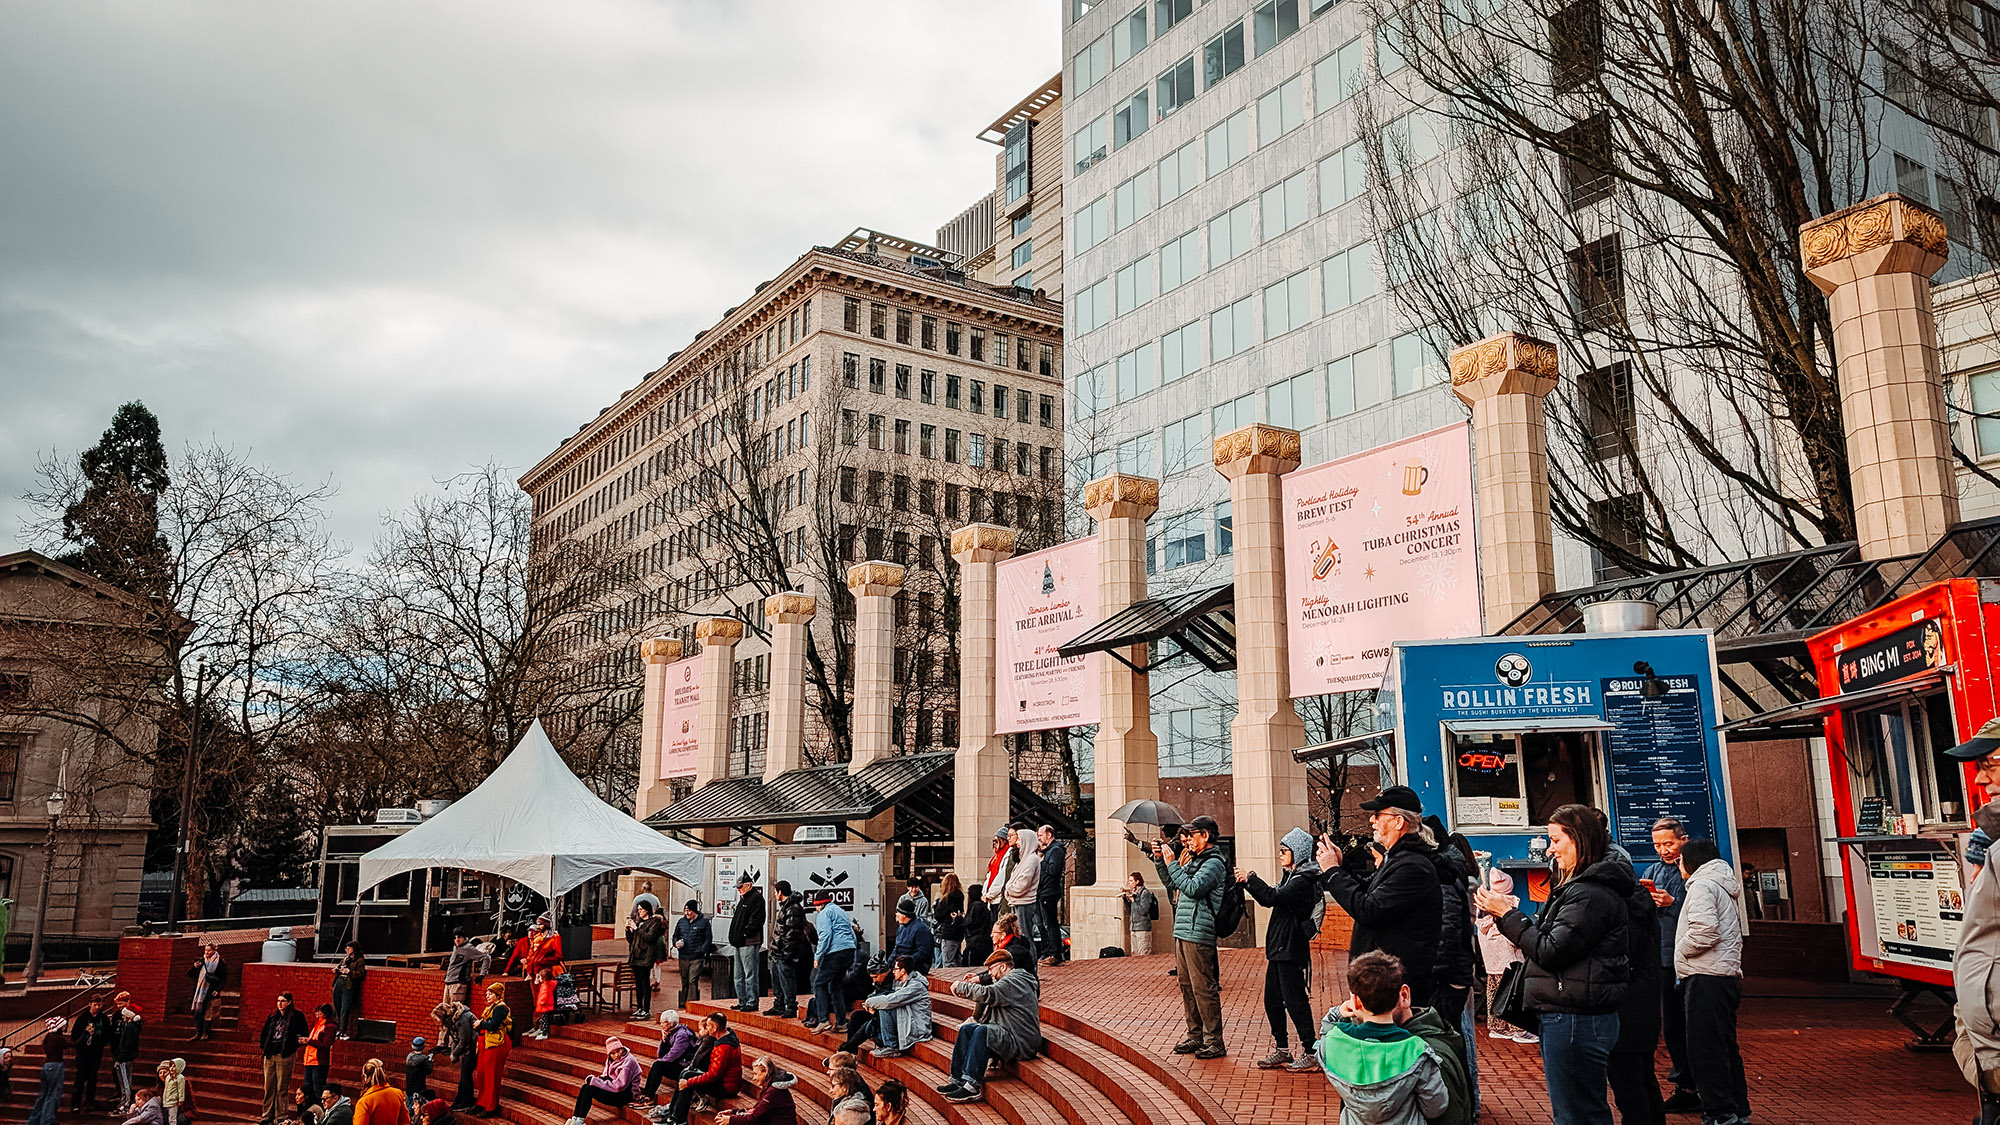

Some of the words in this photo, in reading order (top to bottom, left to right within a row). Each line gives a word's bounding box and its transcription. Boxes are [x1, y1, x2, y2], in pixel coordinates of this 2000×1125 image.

[1296, 492, 1328, 508] Portland
[1329, 486, 1359, 499] Holiday
[1297, 505, 1327, 521] BREW
[1329, 498, 1353, 514] FEST
[1406, 513, 1425, 527] 34th
[1427, 505, 1459, 522] Annual
[1297, 519, 1324, 530] December
[1362, 536, 1392, 552] TUBA
[1394, 520, 1460, 544] CHRISTMAS
[1407, 533, 1460, 555] CONCERT
[1399, 554, 1430, 566] December
[1050, 599, 1070, 611] Lumber
[1301, 594, 1330, 609] Nightly
[1301, 602, 1355, 621] MENORAH
[1357, 592, 1409, 612] LIGHTING
[1015, 617, 1037, 631] TREE
[1038, 609, 1073, 627] ARRIVAL
[1302, 620, 1330, 629] December
[1905, 640, 1916, 650] PDX
[1361, 647, 1390, 660] KGW8
[1902, 652, 1912, 663] EST.
[1912, 649, 1922, 660] 2014
[1014, 660, 1034, 673] TREE
[1036, 655, 1076, 670] LIGHTING
[1860, 651, 1885, 678] BING
[1886, 646, 1900, 669] MI
[1014, 673, 1035, 681] FEATURING
[1327, 671, 1385, 684] THESQUAREPDX.ORG
[1524, 686, 1591, 705] FRESH
[1459, 753, 1506, 769] OPEN
